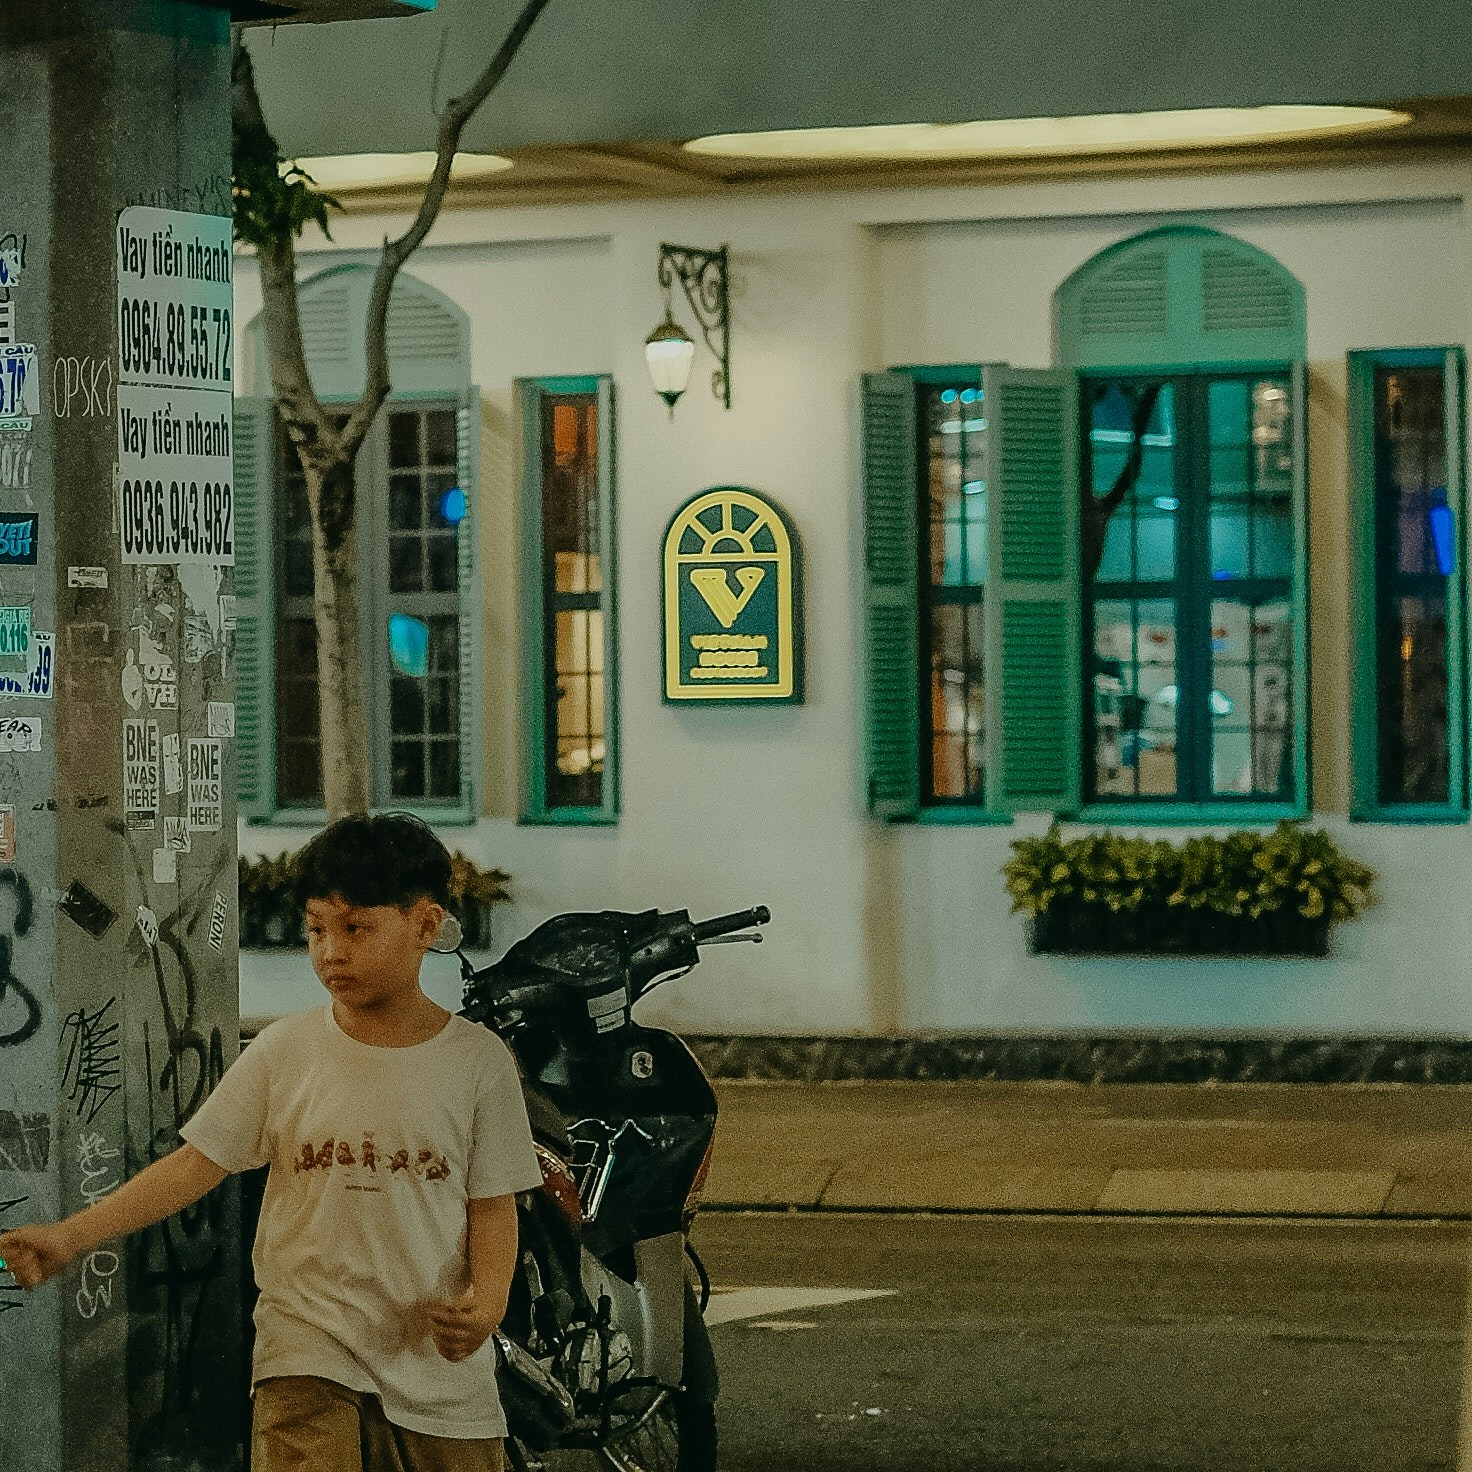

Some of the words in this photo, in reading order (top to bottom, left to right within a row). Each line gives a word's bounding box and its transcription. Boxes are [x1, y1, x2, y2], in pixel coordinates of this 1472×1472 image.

[120, 227, 147, 279] Vay
[153, 224, 182, 278] tiền
[186, 237, 231, 283] nhanh
[121, 297, 231, 382] 0964.89.55.72
[121, 408, 148, 459] Vay
[152, 402, 182, 455] tiền
[186, 412, 229, 457] nhanh
[123, 479, 232, 556] 0936.943.982
[127, 725, 157, 763] BNE
[190, 744, 218, 780] BNE
[128, 766, 157, 785] WAS
[191, 784, 218, 803] WAS
[128, 788, 157, 808] HERE
[190, 806, 219, 826] HERE
